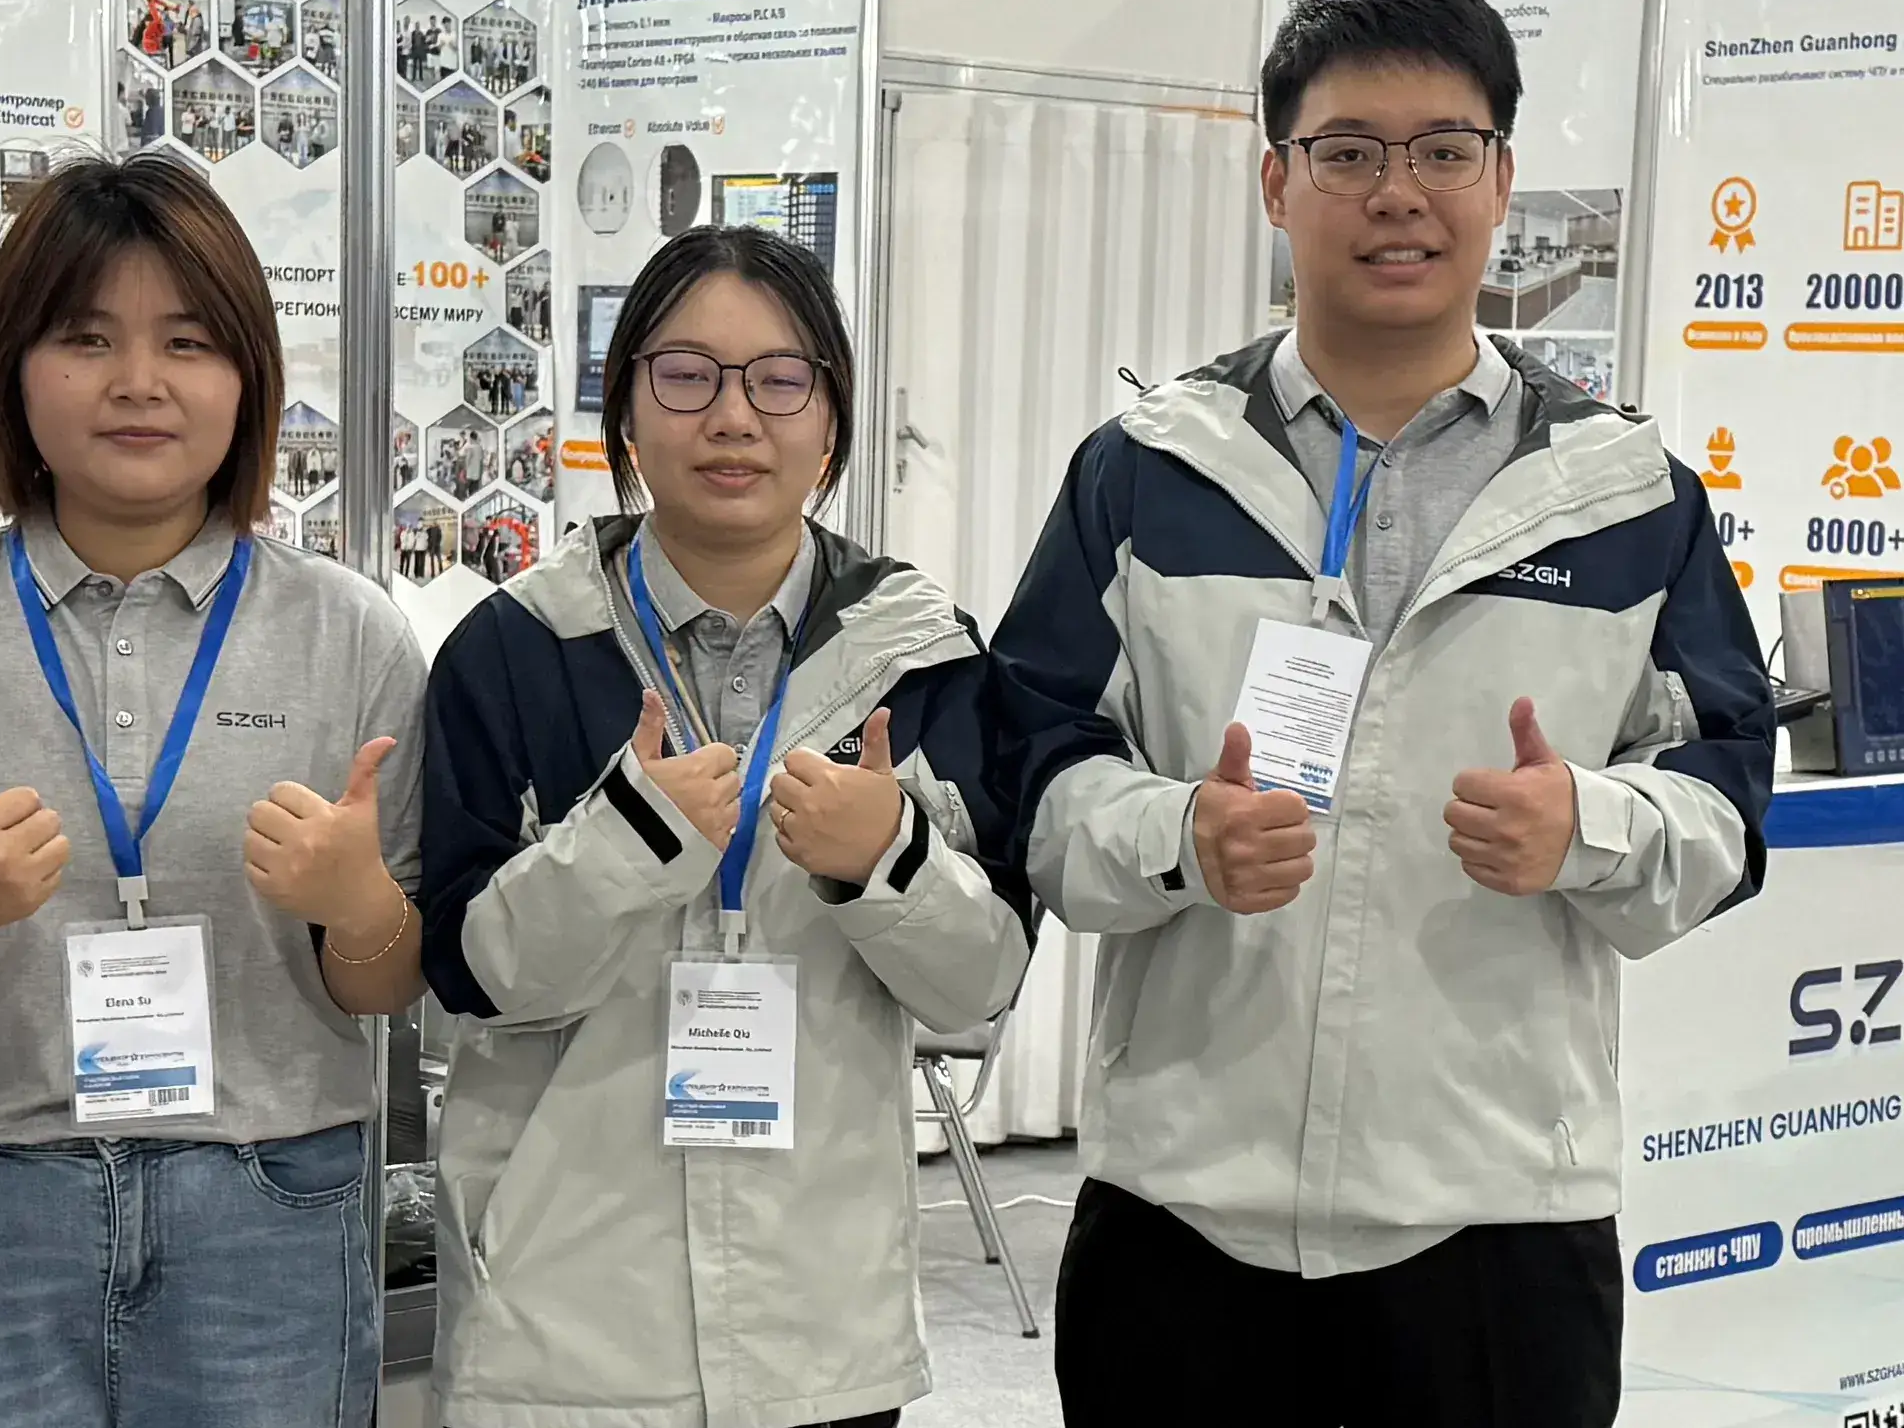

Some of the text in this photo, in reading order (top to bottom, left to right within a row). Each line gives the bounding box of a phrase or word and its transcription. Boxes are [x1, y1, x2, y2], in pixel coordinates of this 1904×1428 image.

[1704, 38, 1794, 58] ShenZhen
[1800, 31, 1898, 53] Guanhong
[412, 260, 490, 290] 100+
[1695, 272, 1765, 310] 2013
[275, 301, 341, 317] РЕГИОН
[444, 306, 484, 323] МИРУ
[216, 711, 287, 729] SZGH
[1642, 1116, 1764, 1163] SHENZHEN
[1770, 1095, 1902, 1141] GUANHONG
[1655, 1246, 1716, 1280] станки
[1730, 1231, 1762, 1264] ЧПУ
